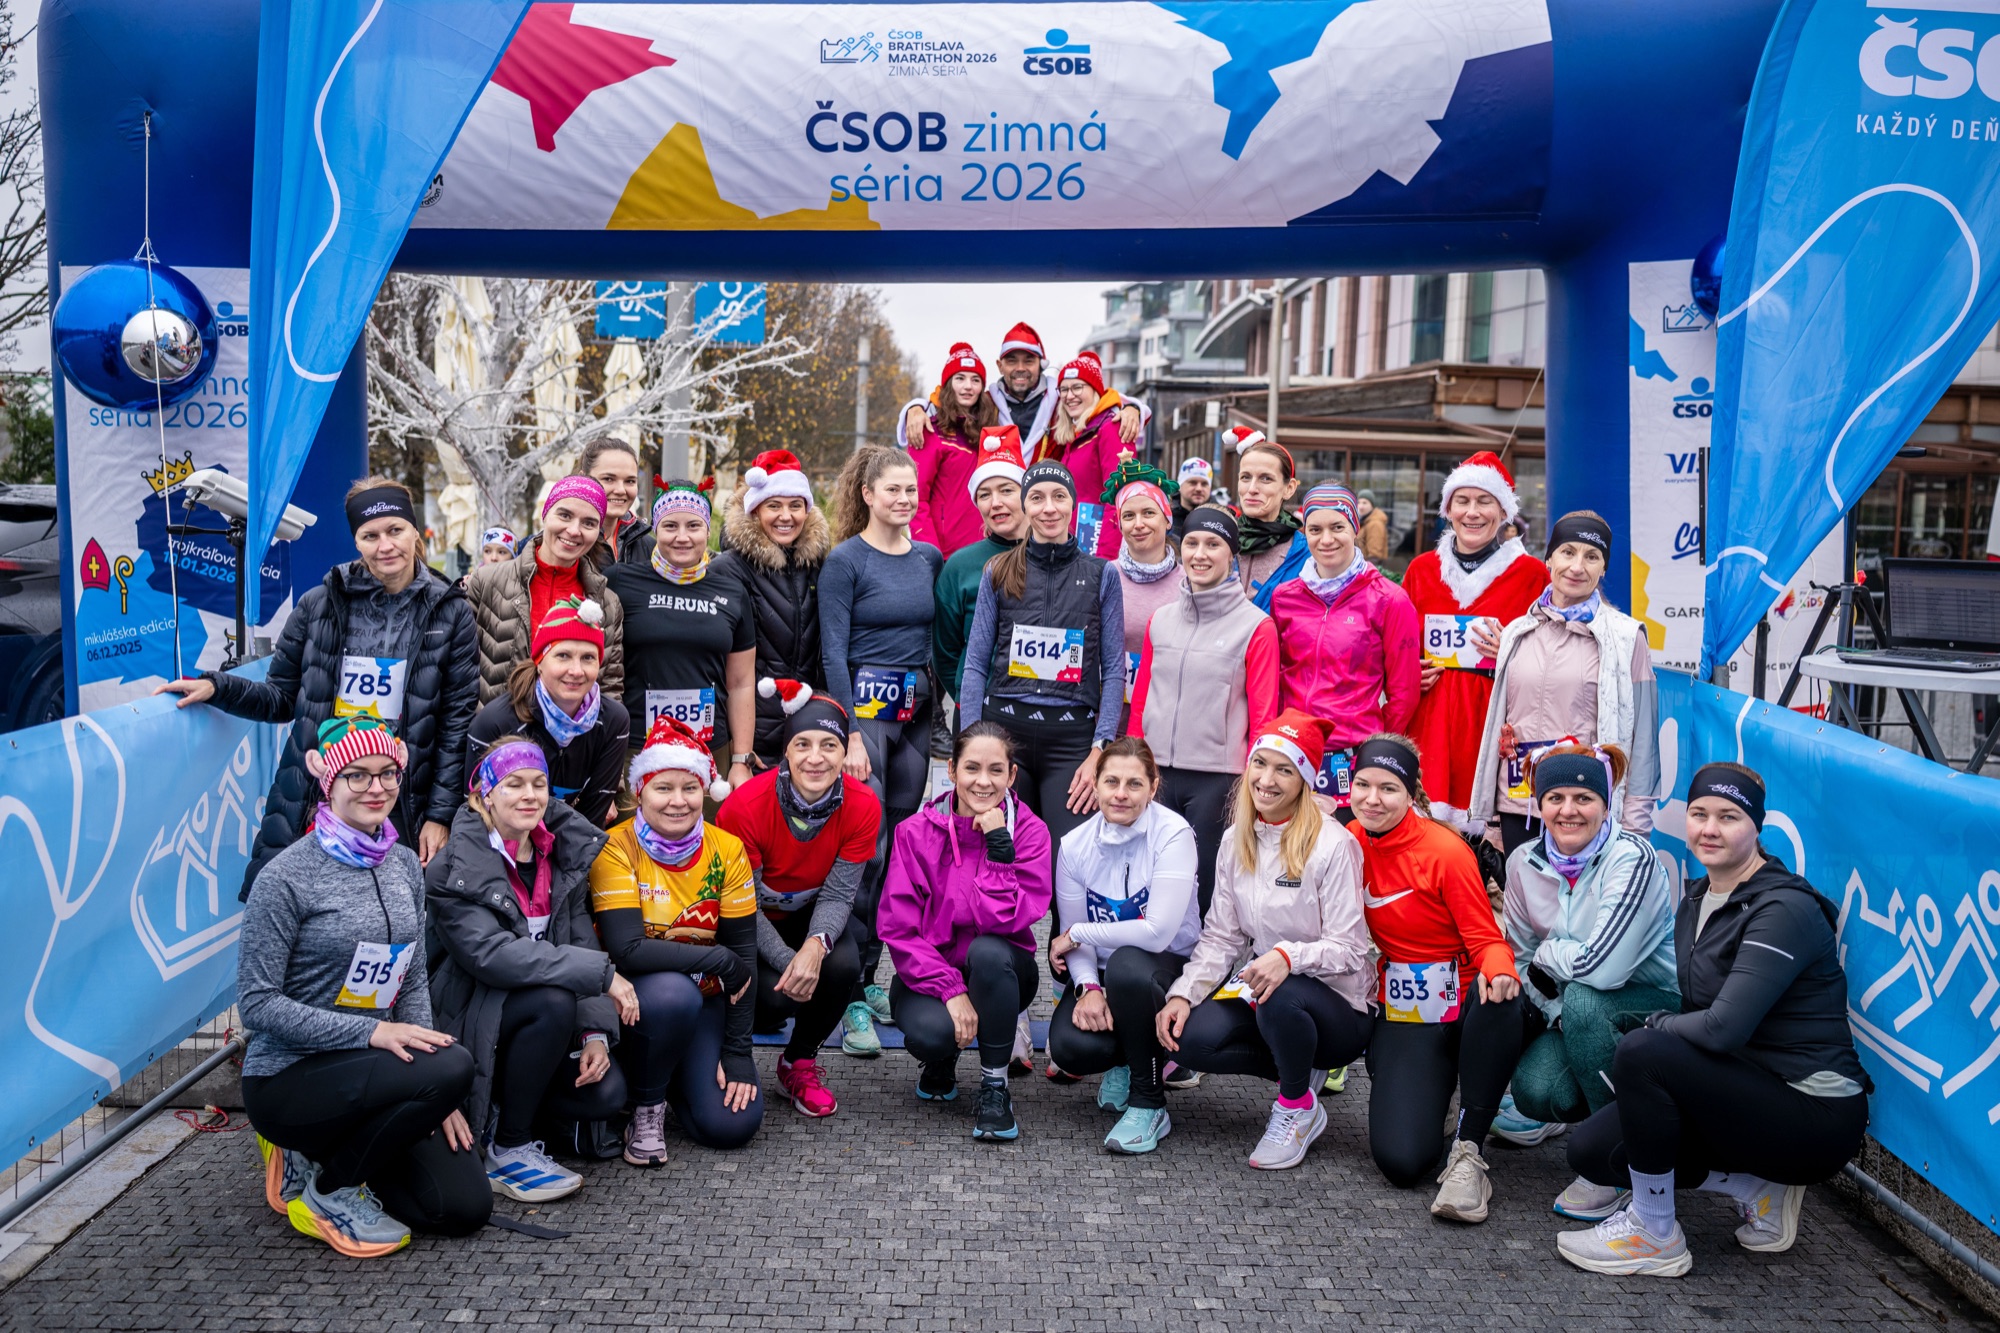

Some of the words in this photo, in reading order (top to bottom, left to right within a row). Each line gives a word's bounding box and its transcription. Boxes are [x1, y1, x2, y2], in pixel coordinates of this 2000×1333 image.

[888, 29, 923, 40] ČSOB
[888, 41, 965, 51] BRATISLAVA
[888, 53, 962, 63] MARATHON
[966, 53, 998, 63] 2026
[1022, 56, 1092, 76] ČSOB
[888, 64, 930, 76] ZIMNÁ
[932, 64, 968, 76] SÉRIA
[805, 100, 948, 153] ČSOB
[962, 110, 1107, 152] zimná
[1856, 111, 1938, 138] KAŽDÝ
[830, 163, 943, 203] séria
[960, 162, 1086, 202] 2026
[1664, 453, 1699, 474] VI
[1032, 467, 1071, 484] TERREX
[1664, 607, 1705, 618] GAR
[84, 625, 137, 646] mikulášska
[139, 617, 176, 634] edícia
[1429, 628, 1466, 649] 813
[86, 639, 142, 662] 06.12.2025
[1015, 638, 1061, 660] 1614
[344, 672, 392, 697] 785
[857, 681, 900, 702] 1170
[649, 704, 701, 722] 1685
[351, 960, 394, 985] 515
[1389, 978, 1430, 1001] 853
